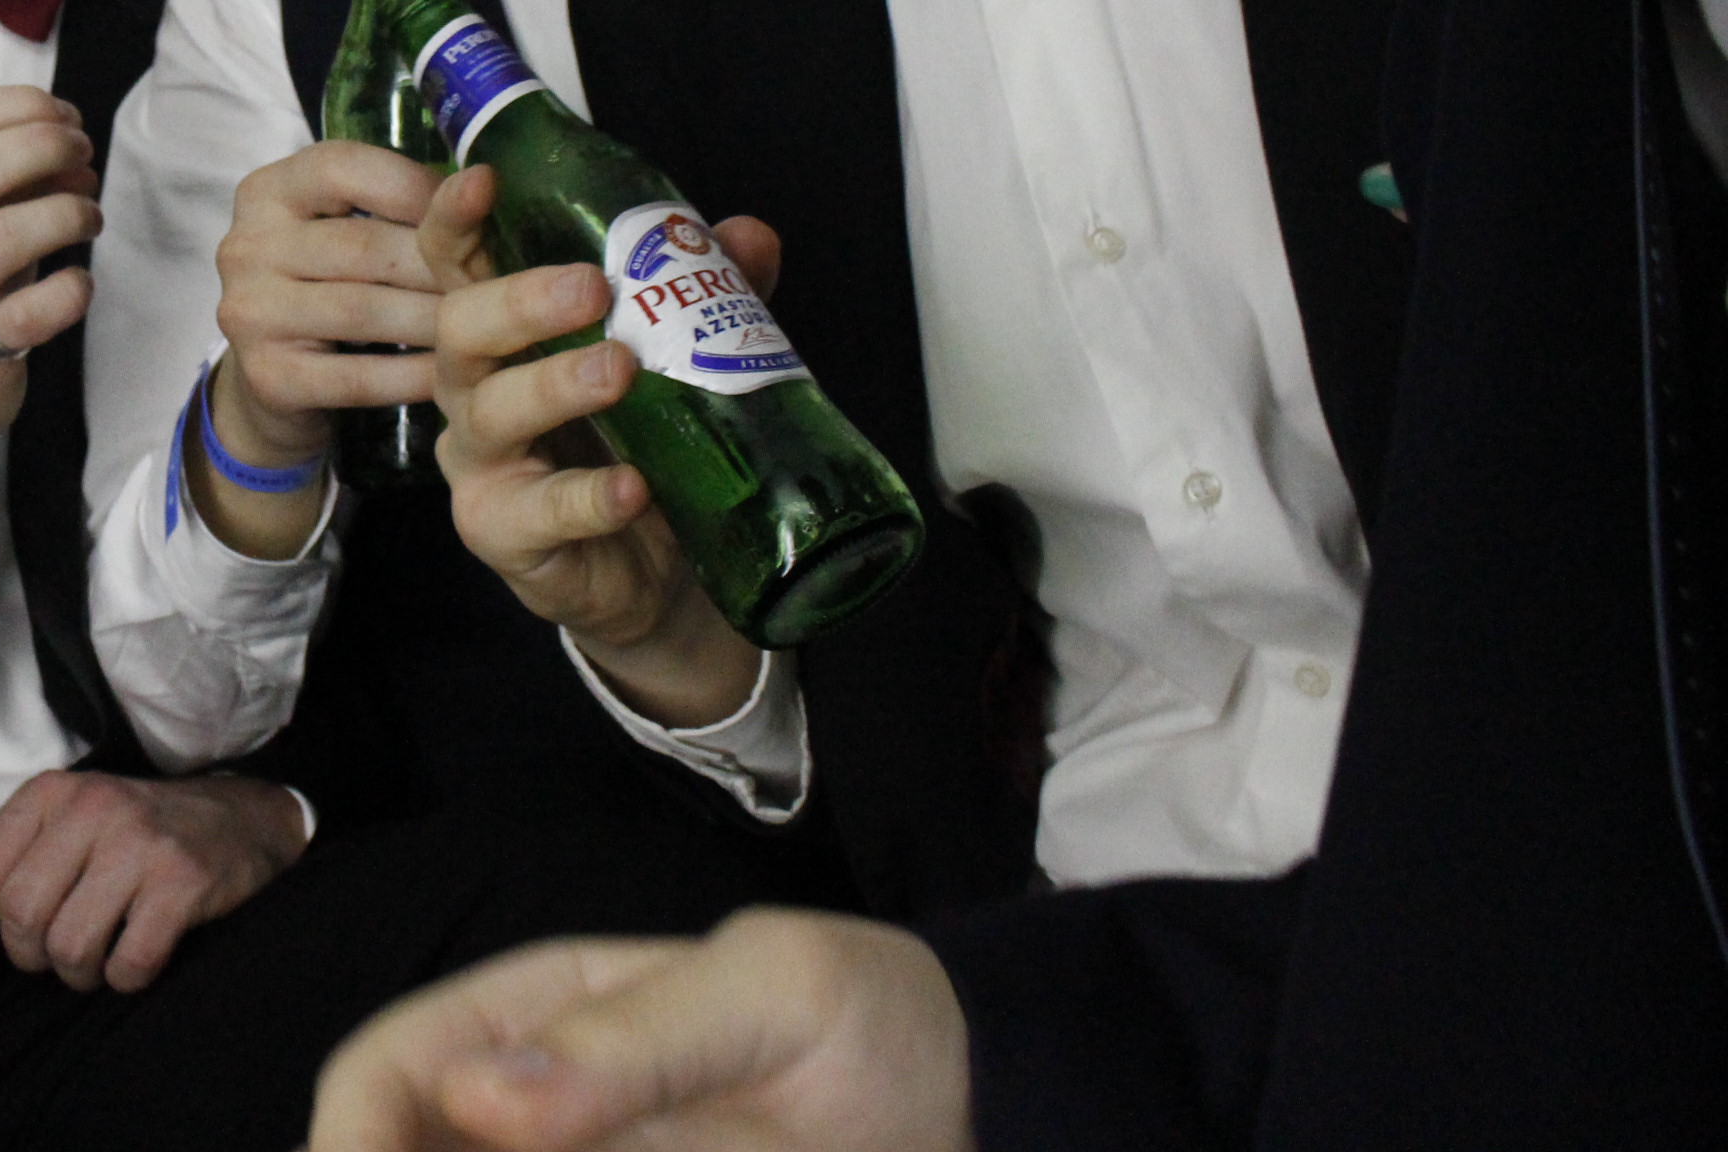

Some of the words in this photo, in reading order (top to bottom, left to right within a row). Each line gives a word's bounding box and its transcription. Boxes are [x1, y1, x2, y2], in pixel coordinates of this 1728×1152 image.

[442, 30, 499, 64] PERO
[631, 268, 751, 326] PERO
[701, 299, 755, 318] NAST
[694, 312, 772, 342] AZZUR
